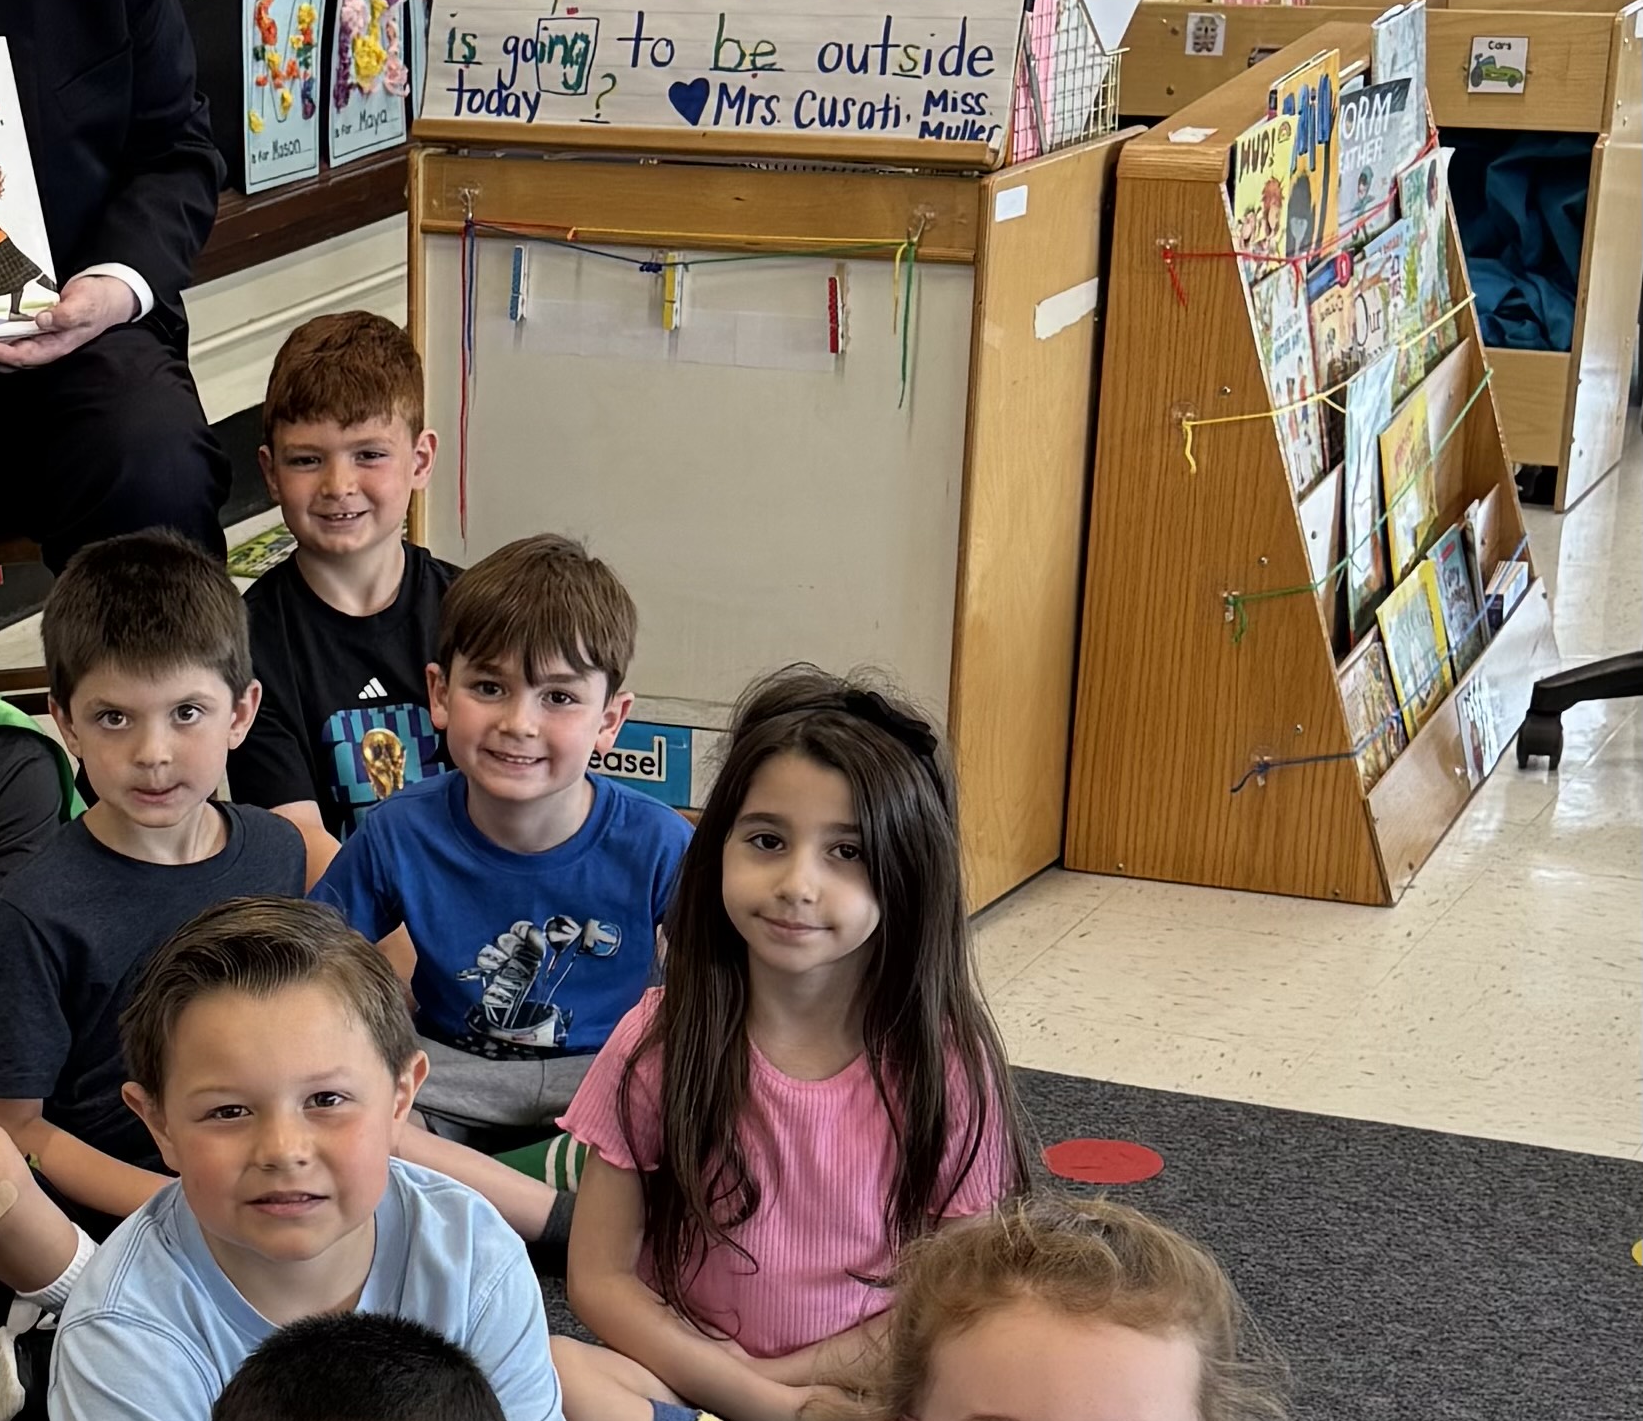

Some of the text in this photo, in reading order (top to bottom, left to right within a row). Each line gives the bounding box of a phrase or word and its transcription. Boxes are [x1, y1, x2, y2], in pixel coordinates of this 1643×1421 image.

[444, 12, 993, 91] is going to be outside
[1488, 41, 1512, 50] Cars
[448, 71, 541, 123] today
[359, 109, 388, 134] Maya
[919, 120, 1001, 141] Muller
[272, 140, 301, 160] Mason
[589, 736, 662, 778] easel
